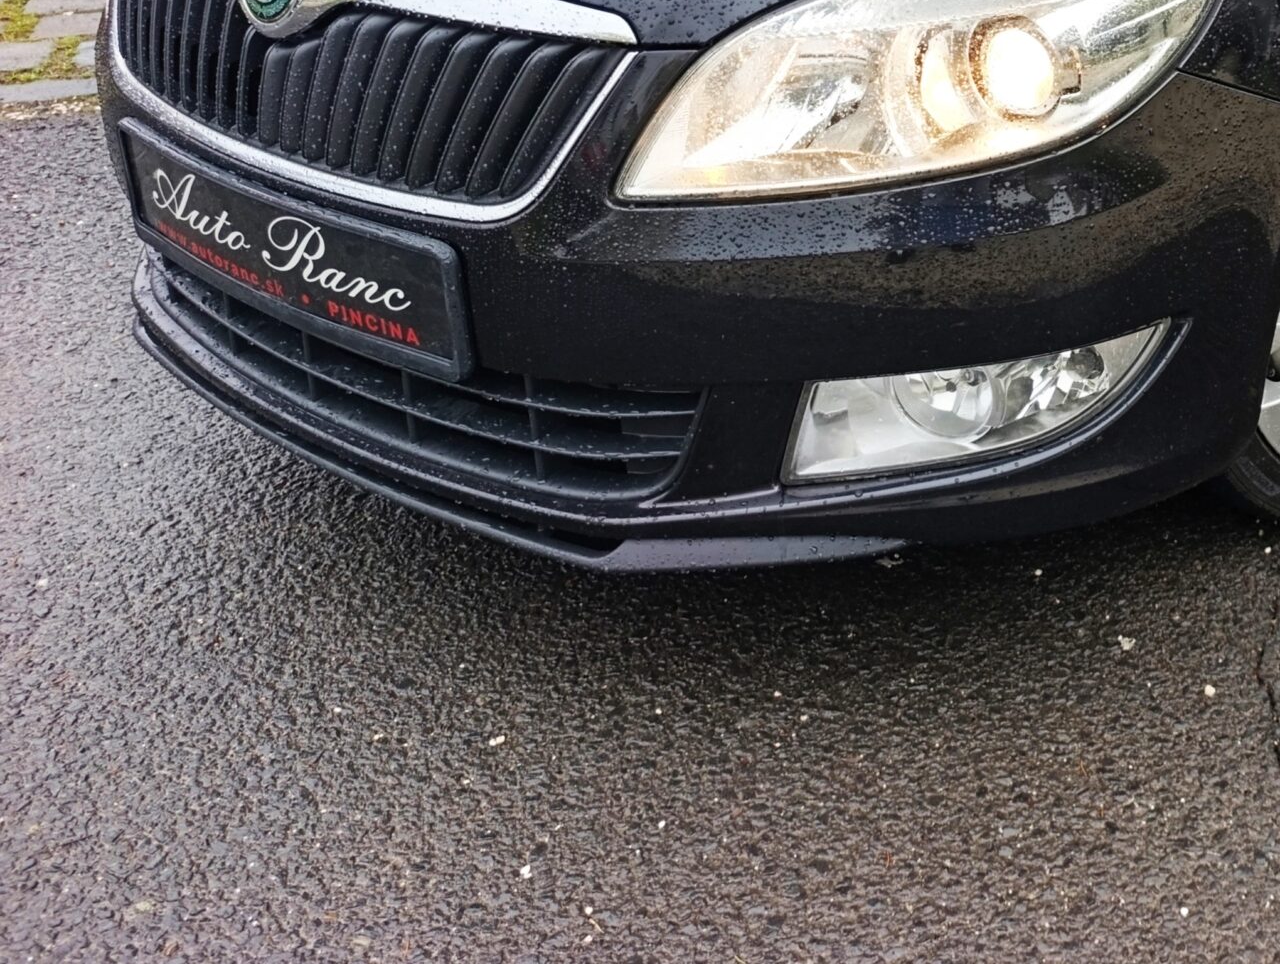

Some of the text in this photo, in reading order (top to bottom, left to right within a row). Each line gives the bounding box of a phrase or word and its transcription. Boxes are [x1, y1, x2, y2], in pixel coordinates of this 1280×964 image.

[152, 168, 412, 311] Auto Ranc
[328, 300, 420, 346] PINCINA
